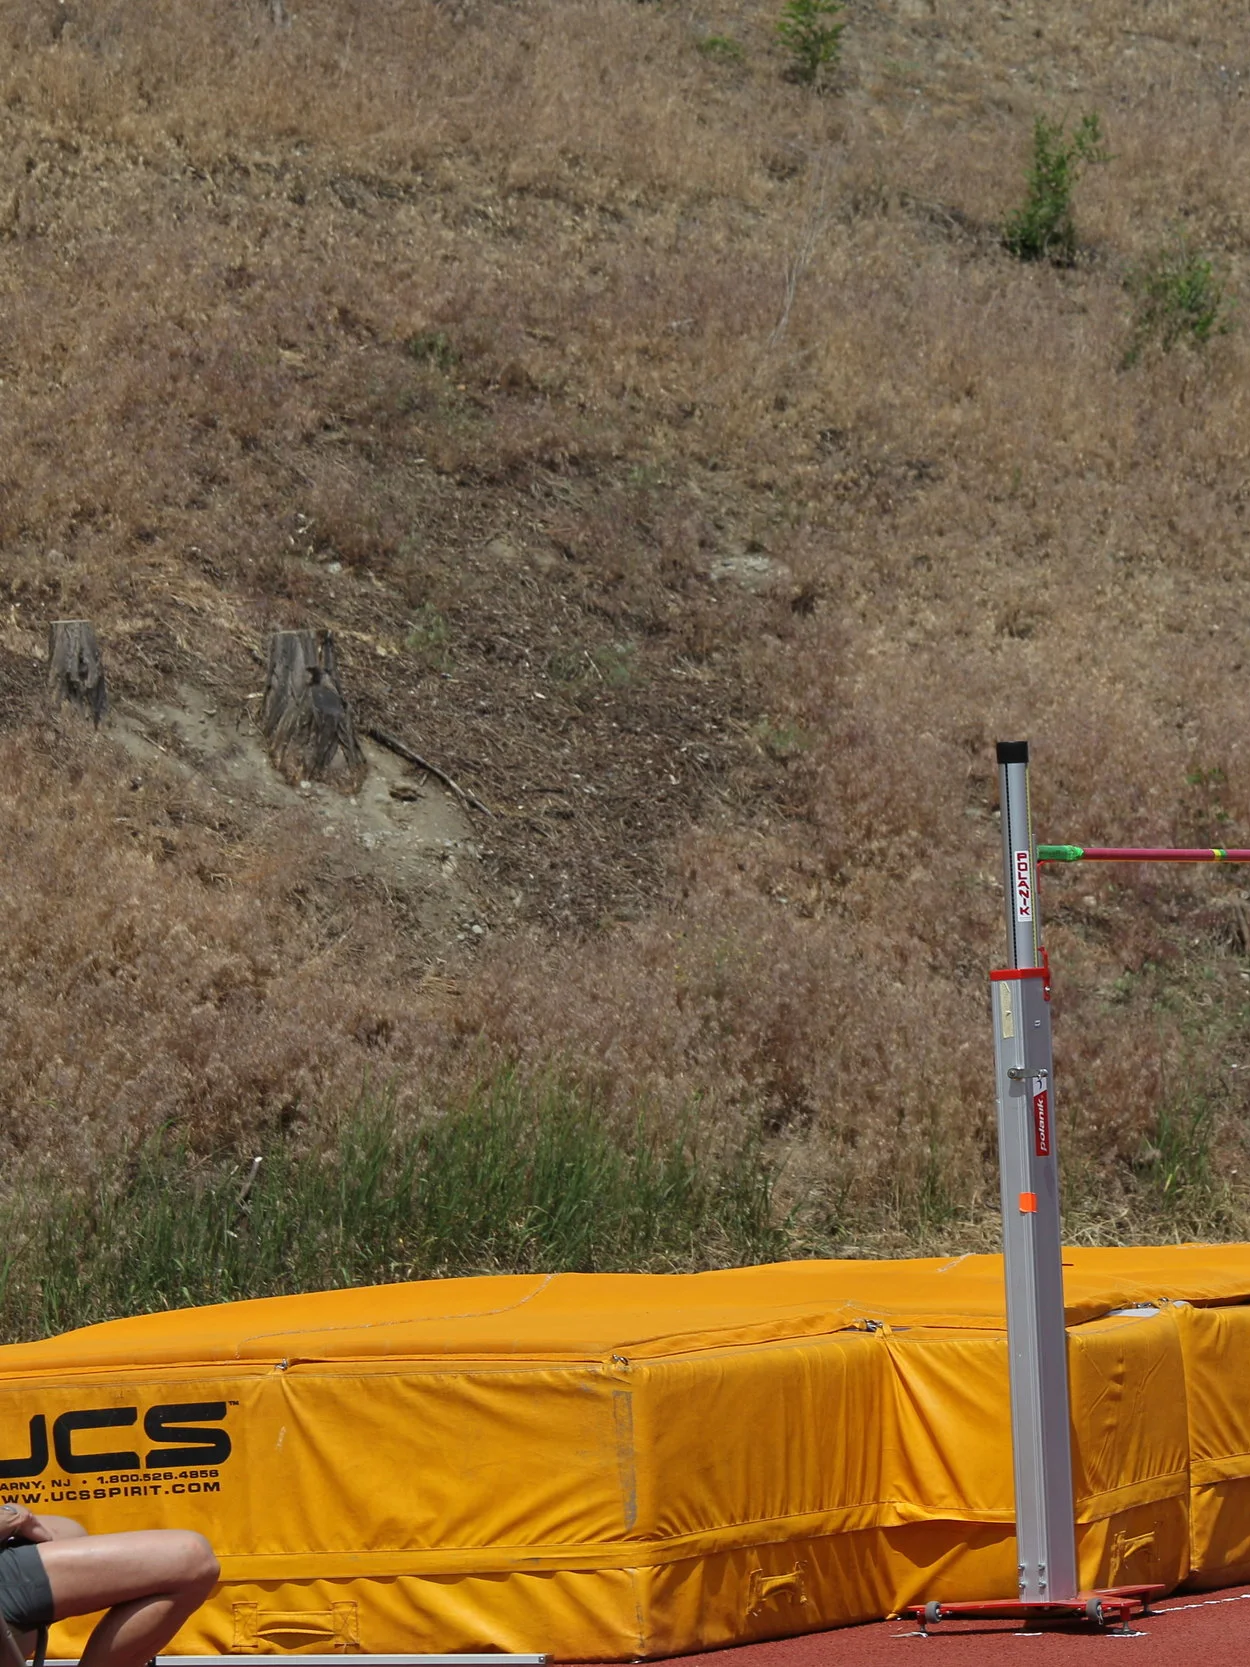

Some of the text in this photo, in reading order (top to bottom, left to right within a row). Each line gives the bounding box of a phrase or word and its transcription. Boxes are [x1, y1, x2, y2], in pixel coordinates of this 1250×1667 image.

[1016, 852, 1030, 916] POLANIK
[1036, 1098, 1048, 1152] polanik
[51, 1478, 71, 1488] NJ
